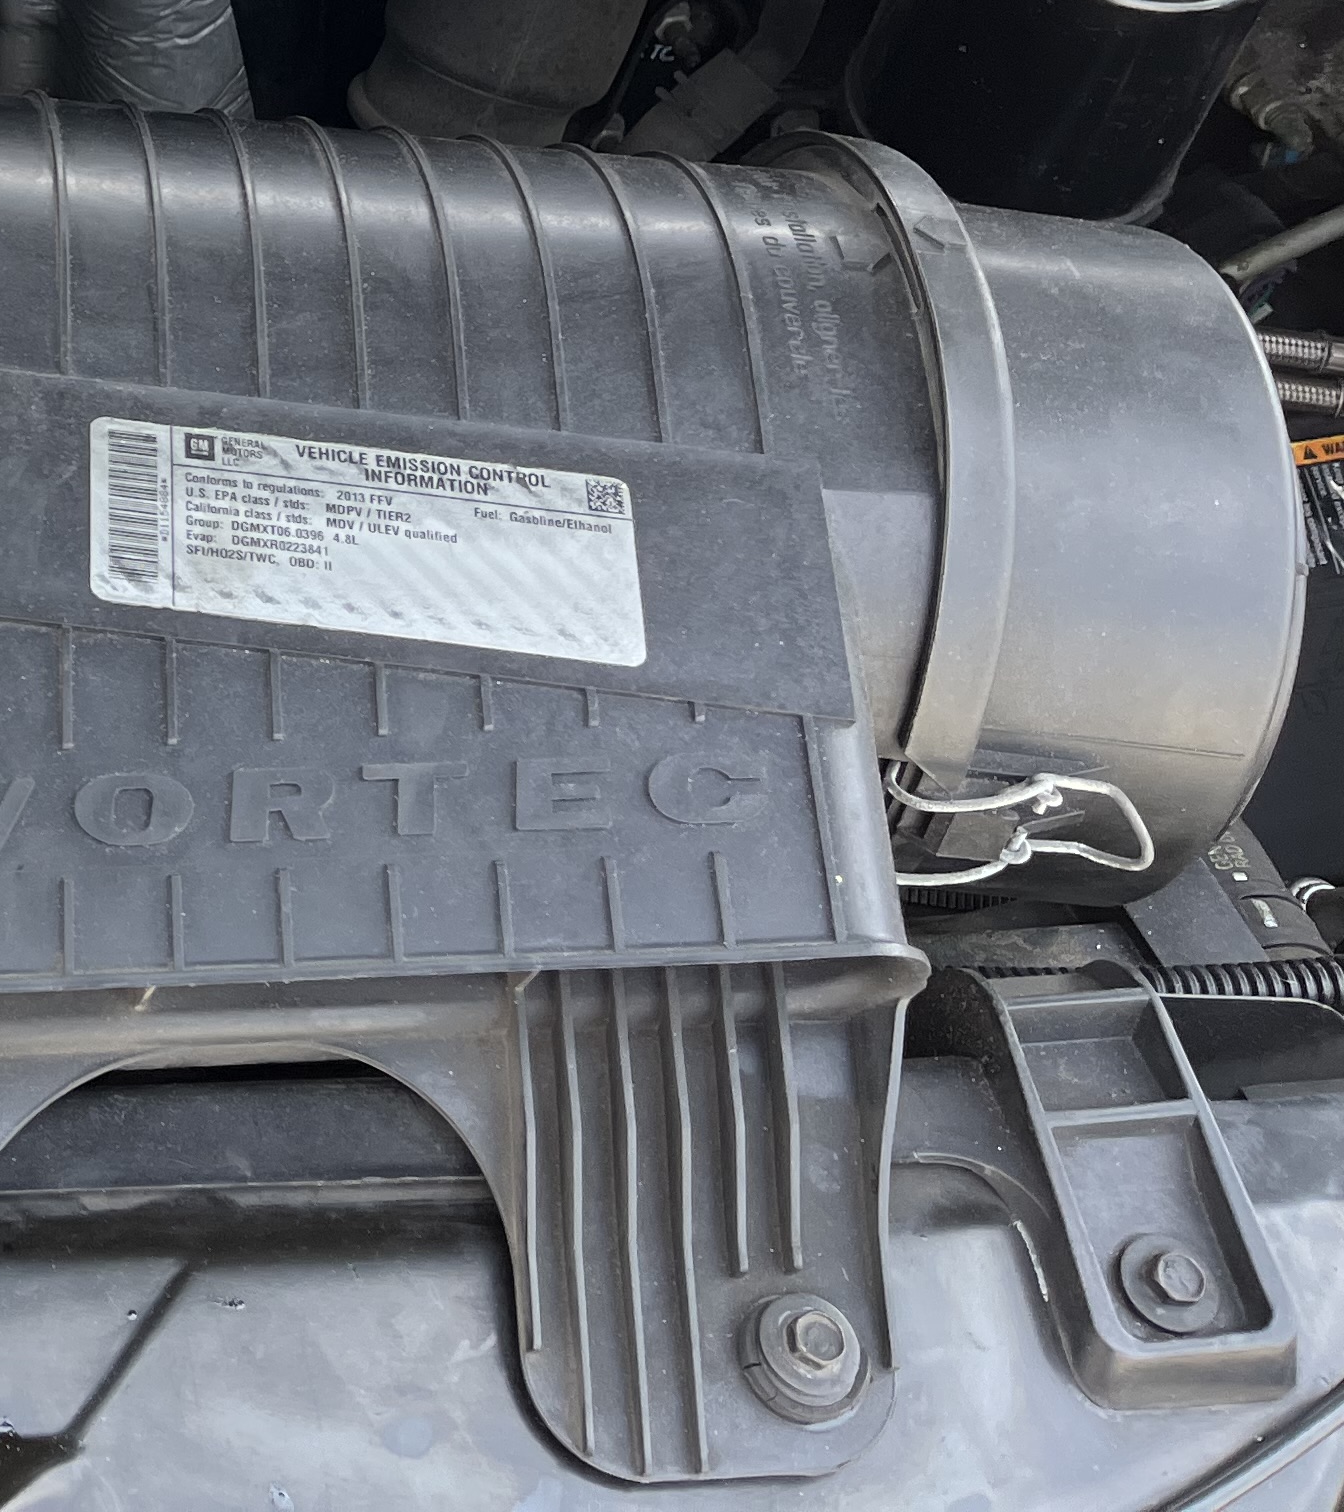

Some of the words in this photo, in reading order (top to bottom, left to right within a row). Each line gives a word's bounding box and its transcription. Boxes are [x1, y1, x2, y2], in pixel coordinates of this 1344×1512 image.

[190, 438, 210, 451] GM
[221, 436, 264, 449] GENERAL
[222, 446, 263, 459] MOTORS
[222, 456, 240, 467] LLC
[295, 445, 368, 466] VEHICLE
[375, 454, 461, 477] EMISSION
[468, 465, 551, 488] CONTROL
[185, 472, 238, 488] Conforms
[243, 479, 253, 490] to
[257, 483, 324, 498] regulations:
[336, 490, 365, 503] 2013
[369, 494, 393, 507] FFV
[364, 468, 489, 496] INFORMATION
[185, 487, 209, 499] U.S.
[215, 491, 237, 502] EPA
[241, 494, 270, 506] class
[283, 499, 310, 510] stds:
[325, 503, 362, 518] MDPV
[375, 509, 412, 524] TIER2
[474, 507, 502, 521] Fuel:
[185, 500, 240, 517] California
[244, 508, 272, 521] class
[285, 513, 312, 525] stds:
[326, 518, 354, 531] MDV
[368, 523, 401, 537] ULEV
[404, 528, 458, 544] qualified
[185, 515, 224, 529] Group:
[332, 533, 359, 545] 4.8L
[186, 530, 218, 544] Evap:
